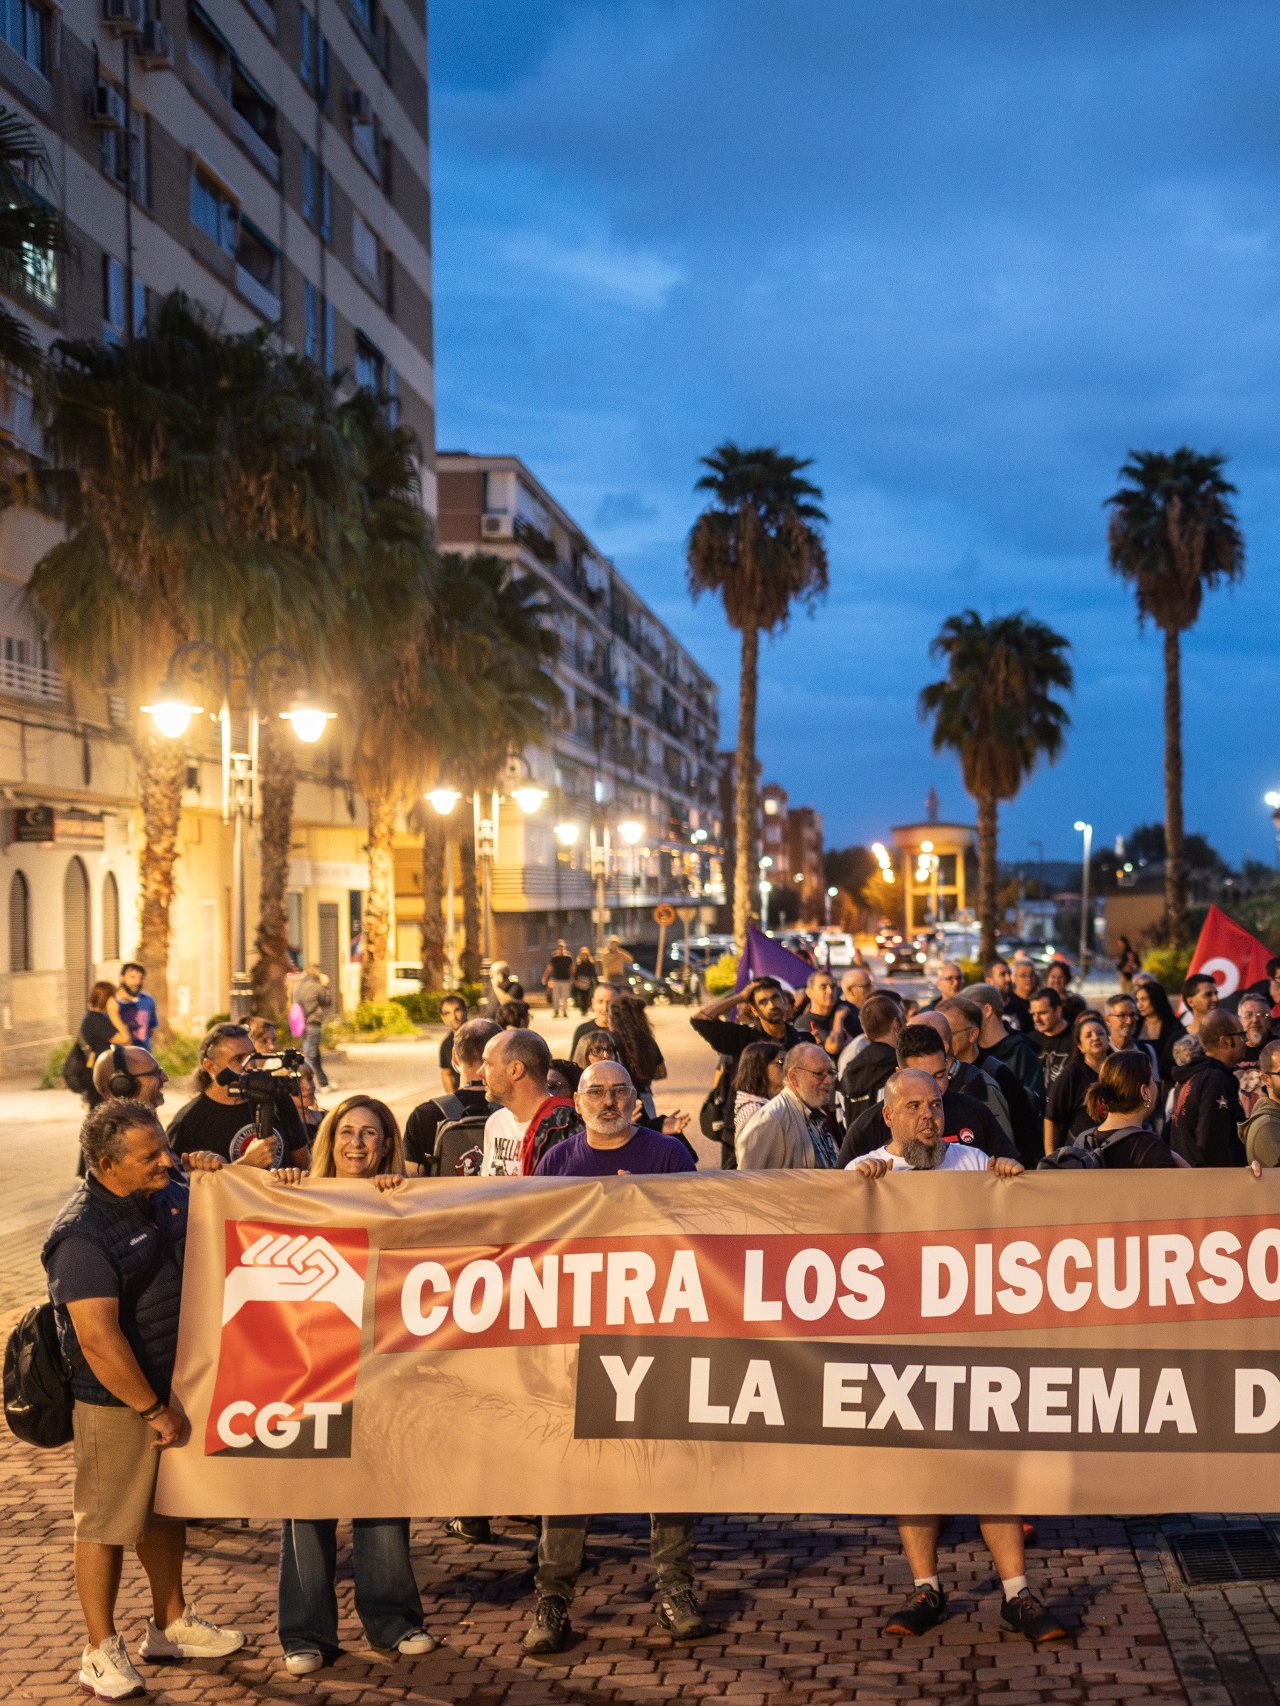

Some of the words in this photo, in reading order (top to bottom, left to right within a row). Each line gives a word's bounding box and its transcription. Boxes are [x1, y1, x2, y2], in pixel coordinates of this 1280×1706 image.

[400, 1249, 709, 1337] CONTRA
[743, 1246, 886, 1322] LOS
[216, 1400, 342, 1450] CGT
[599, 1355, 655, 1423] Y
[688, 1357, 785, 1427] LA
[821, 1362, 1198, 1434] EXTREMA
